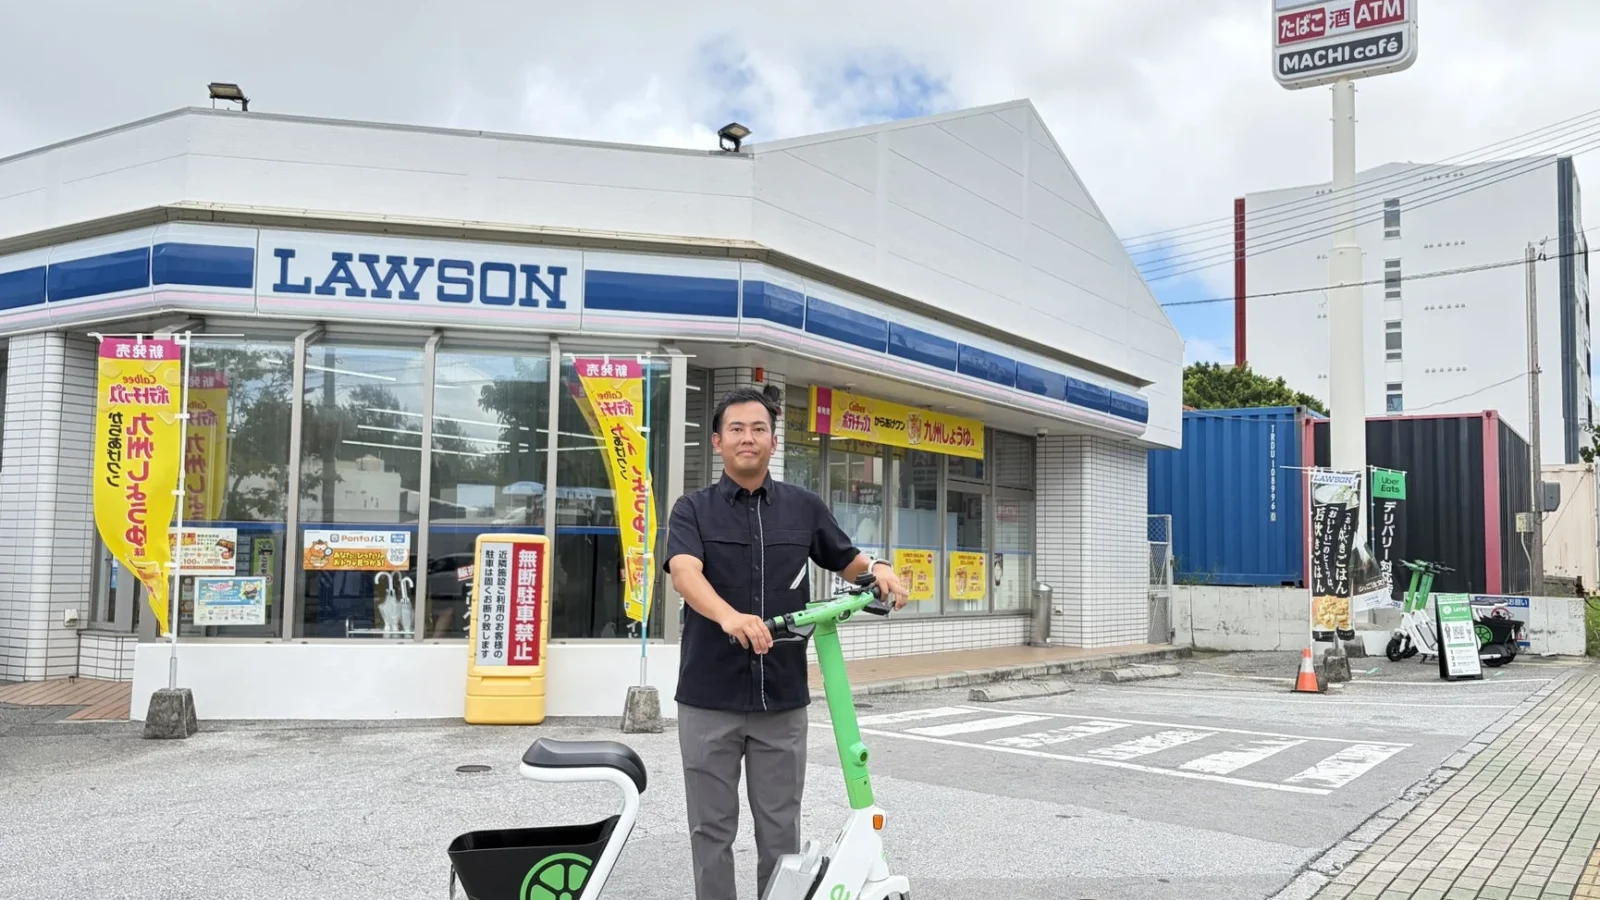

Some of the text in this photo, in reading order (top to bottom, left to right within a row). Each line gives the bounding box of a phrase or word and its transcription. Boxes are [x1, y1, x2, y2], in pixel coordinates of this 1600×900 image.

[1281, 0, 1402, 39] たばこ 酒 ATM
[1283, 38, 1399, 72] MACHI café
[272, 247, 568, 310] LAWSON
[849, 401, 867, 414] Calbee
[842, 411, 871, 433] ポテトチップス
[874, 416, 906, 431] からあげクン
[1313, 474, 1353, 486] LAWSON
[1381, 485, 1400, 494] Eats
[1382, 475, 1400, 485] Uber
[481, 550, 495, 659] 駐車は固くお断り致します
[493, 550, 508, 659] 近隣施設ご利用のお客様の
[513, 549, 538, 661] 無断駐車禁止
